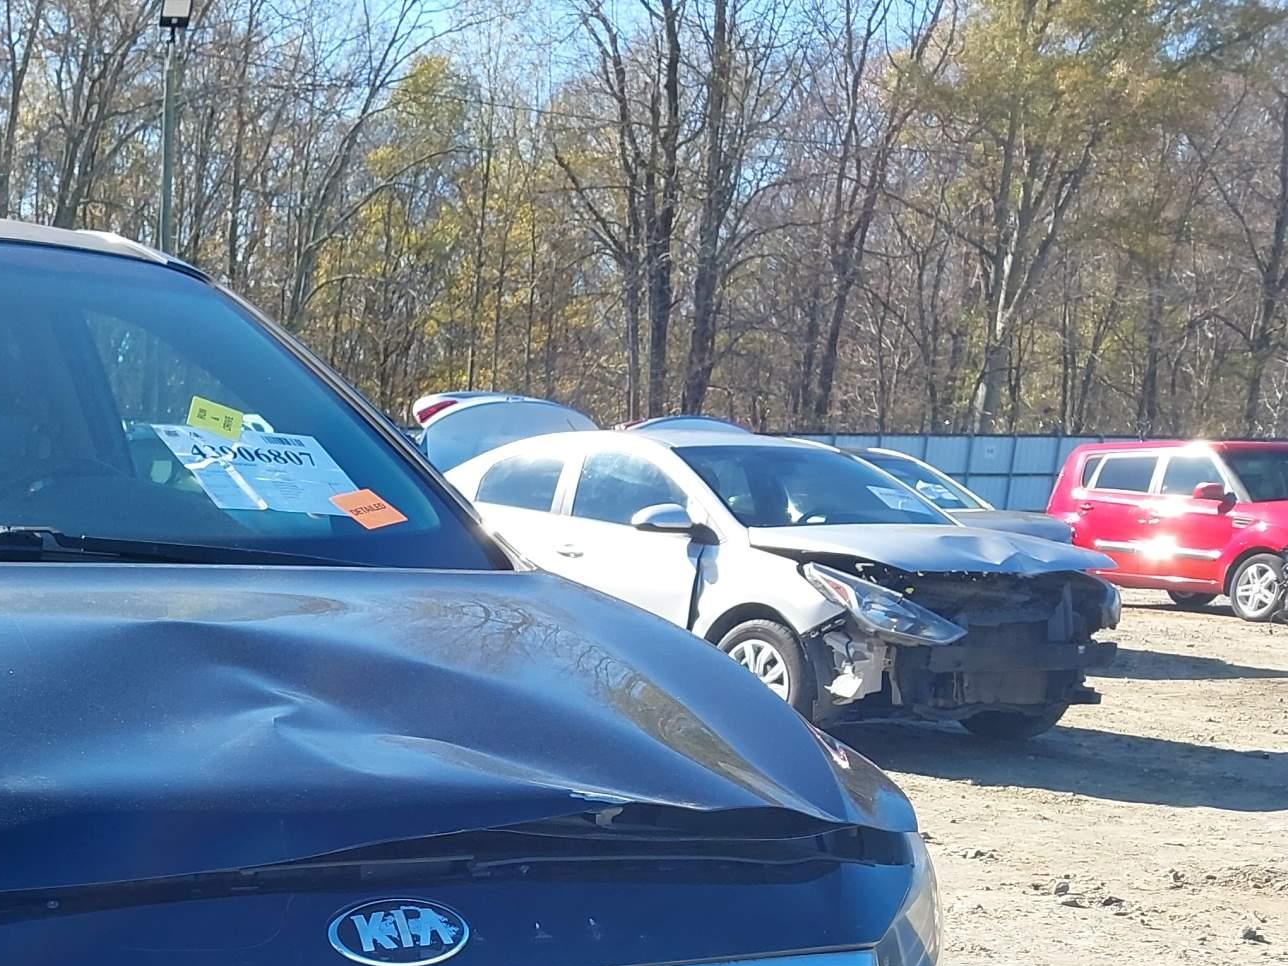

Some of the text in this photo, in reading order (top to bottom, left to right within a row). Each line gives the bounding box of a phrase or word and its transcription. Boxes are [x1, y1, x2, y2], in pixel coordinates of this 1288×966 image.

[191, 443, 316, 467] 43906807
[349, 502, 386, 516] DETAILED
[350, 905, 458, 952] KIA
